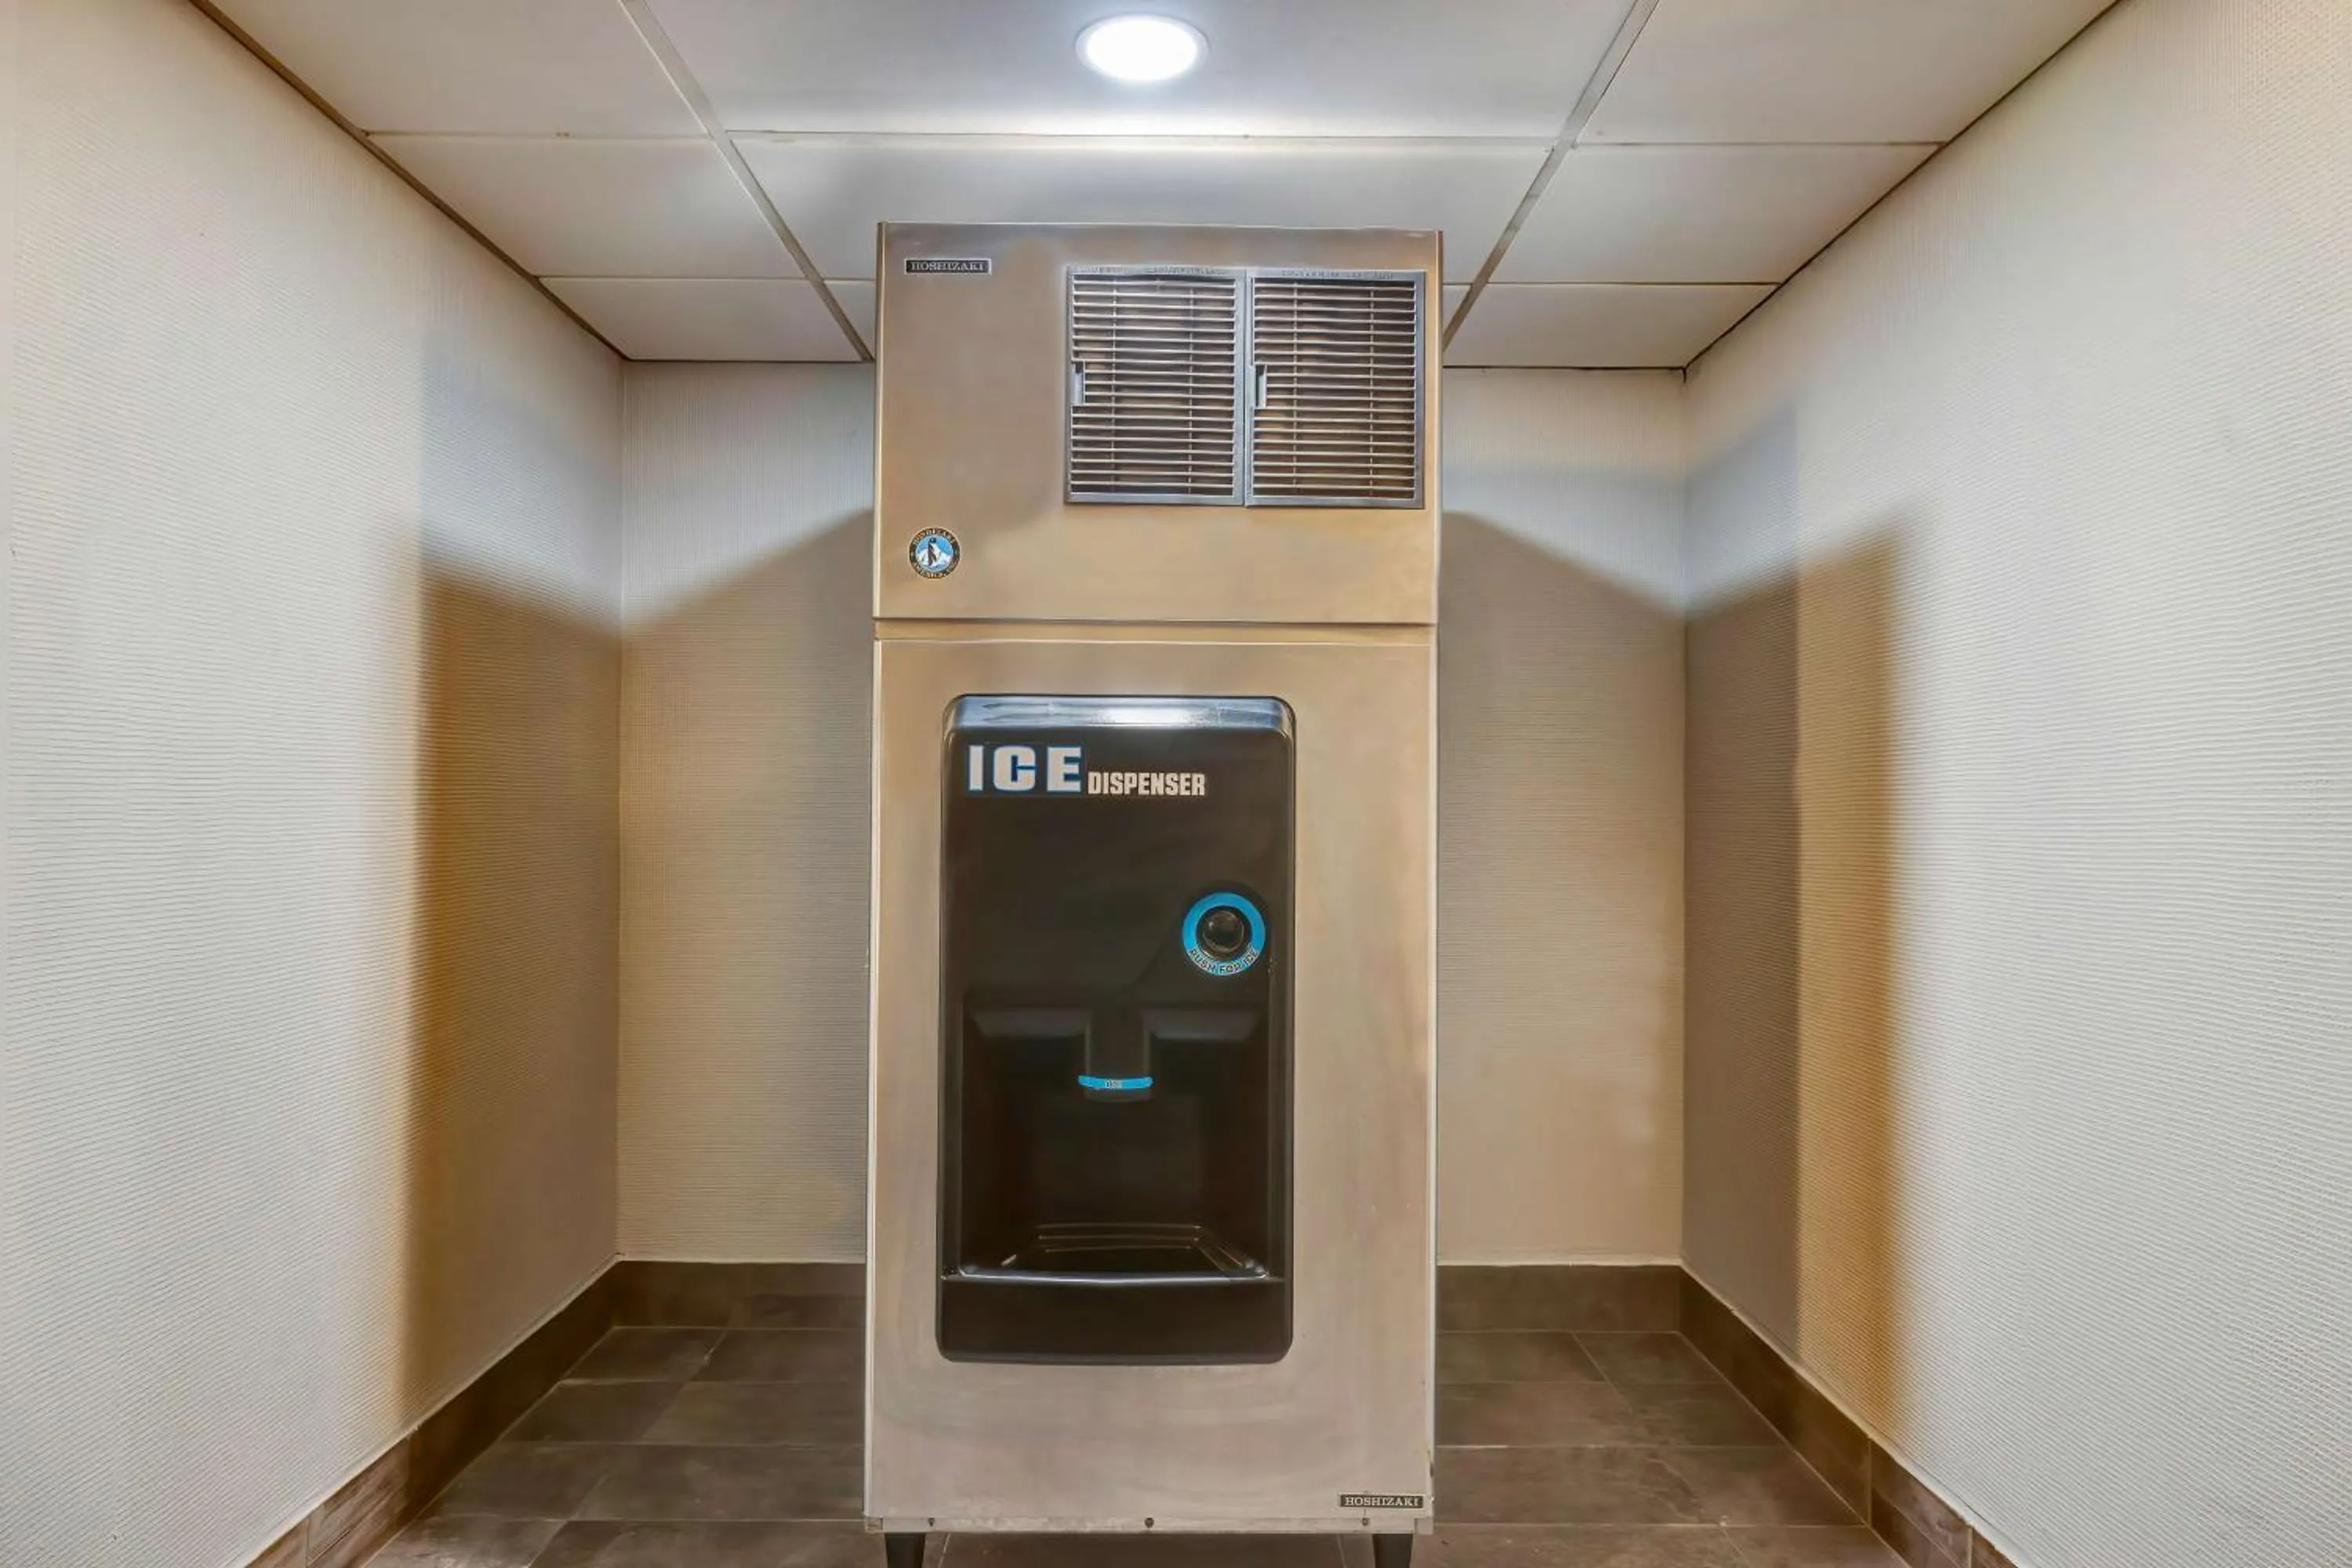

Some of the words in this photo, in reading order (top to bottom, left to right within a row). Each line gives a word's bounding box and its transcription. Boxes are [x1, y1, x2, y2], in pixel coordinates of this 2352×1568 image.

[910, 261, 984, 271] HOSHIZAKI
[968, 745, 1081, 792] ICE
[1087, 771, 1206, 797] DISPENSER
[1190, 948, 1217, 973] PUSH
[1219, 962, 1242, 974] FOR
[1243, 947, 1259, 965] ICE
[1344, 1496, 1419, 1506] HOSHIZAKI
